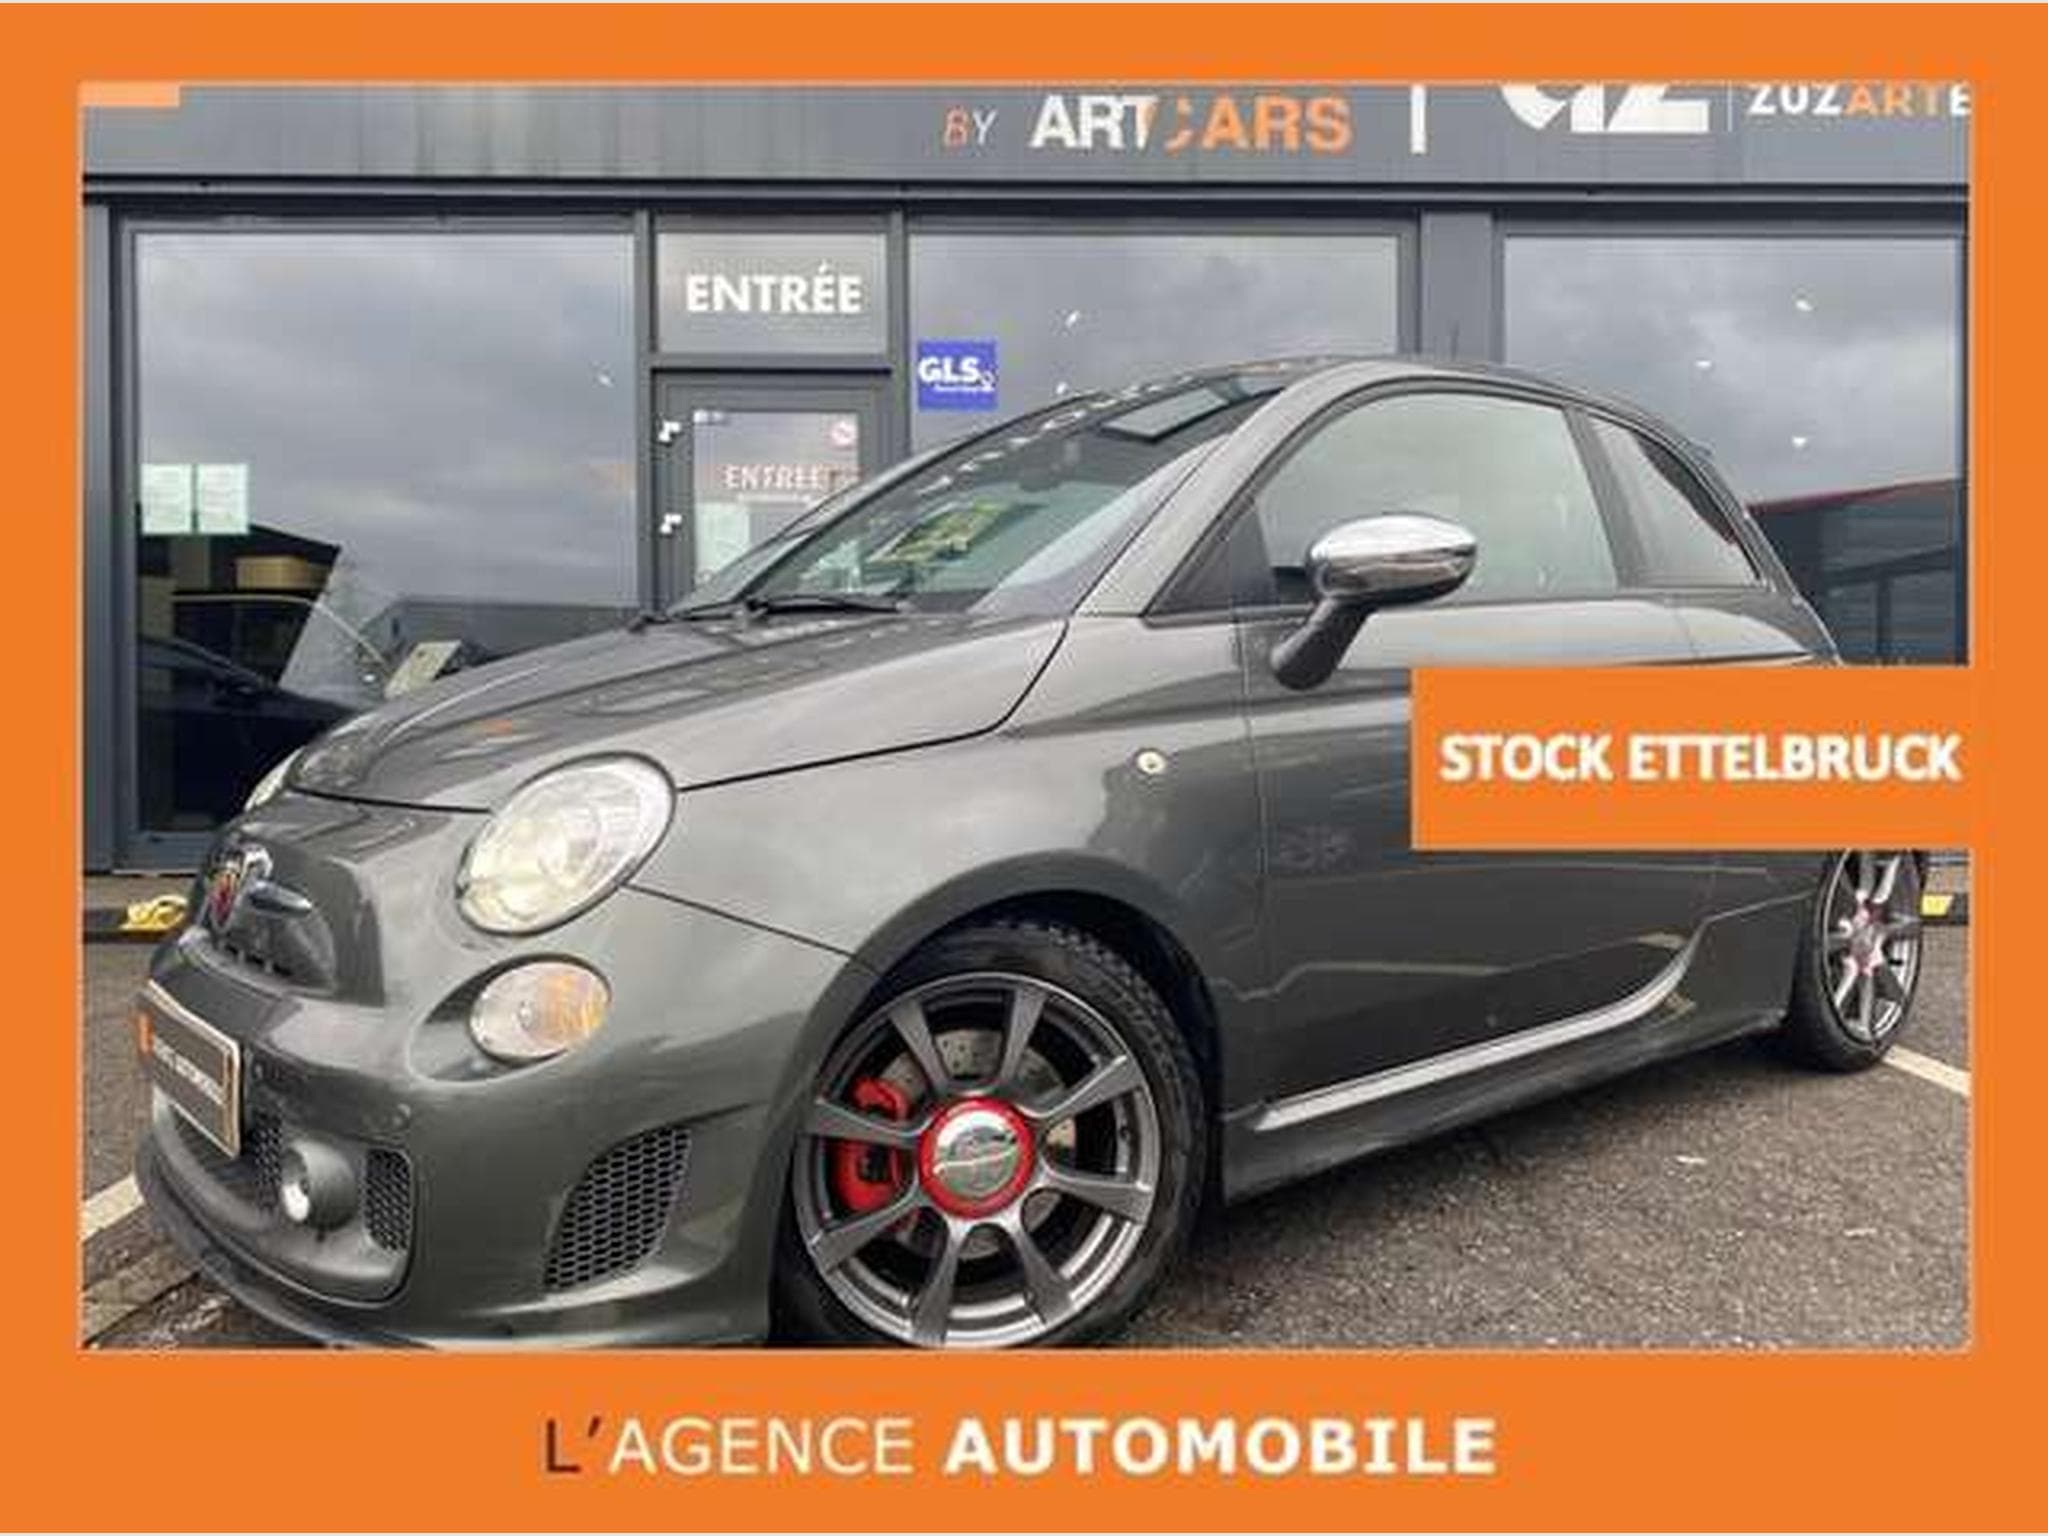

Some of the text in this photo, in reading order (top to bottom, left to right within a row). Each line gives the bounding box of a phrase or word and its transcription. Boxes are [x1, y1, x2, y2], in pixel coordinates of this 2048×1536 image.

[943, 106, 997, 146] BY
[685, 259, 863, 315] ENTRÉE
[918, 356, 981, 383] GLS
